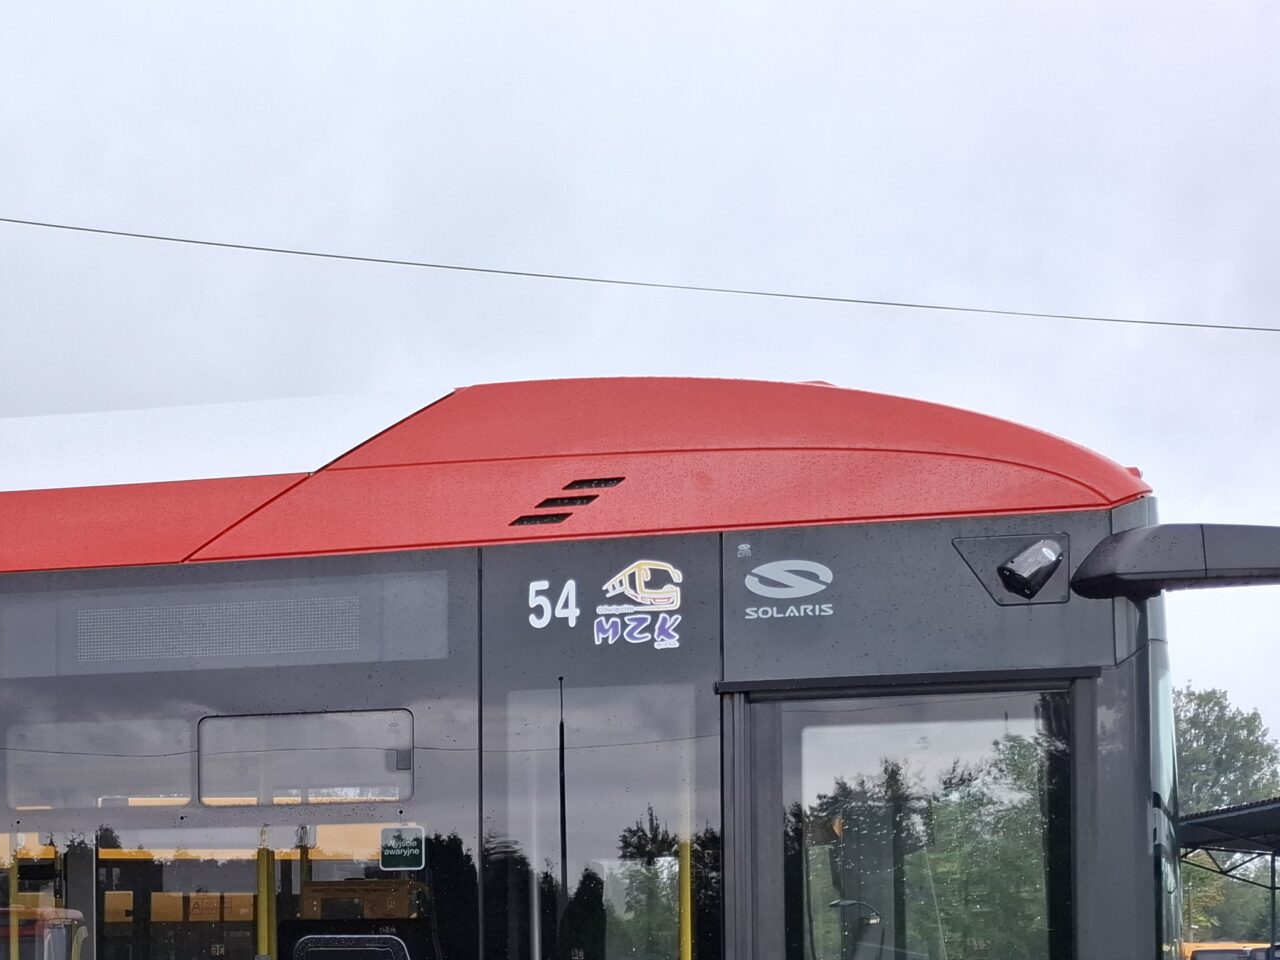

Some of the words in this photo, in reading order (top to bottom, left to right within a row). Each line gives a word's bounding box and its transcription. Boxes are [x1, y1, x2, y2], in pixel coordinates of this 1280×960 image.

[528, 579, 580, 629] 54
[745, 604, 834, 619] SOLARIS
[594, 613, 681, 645] MZK
[384, 848, 419, 856] awaryjne
